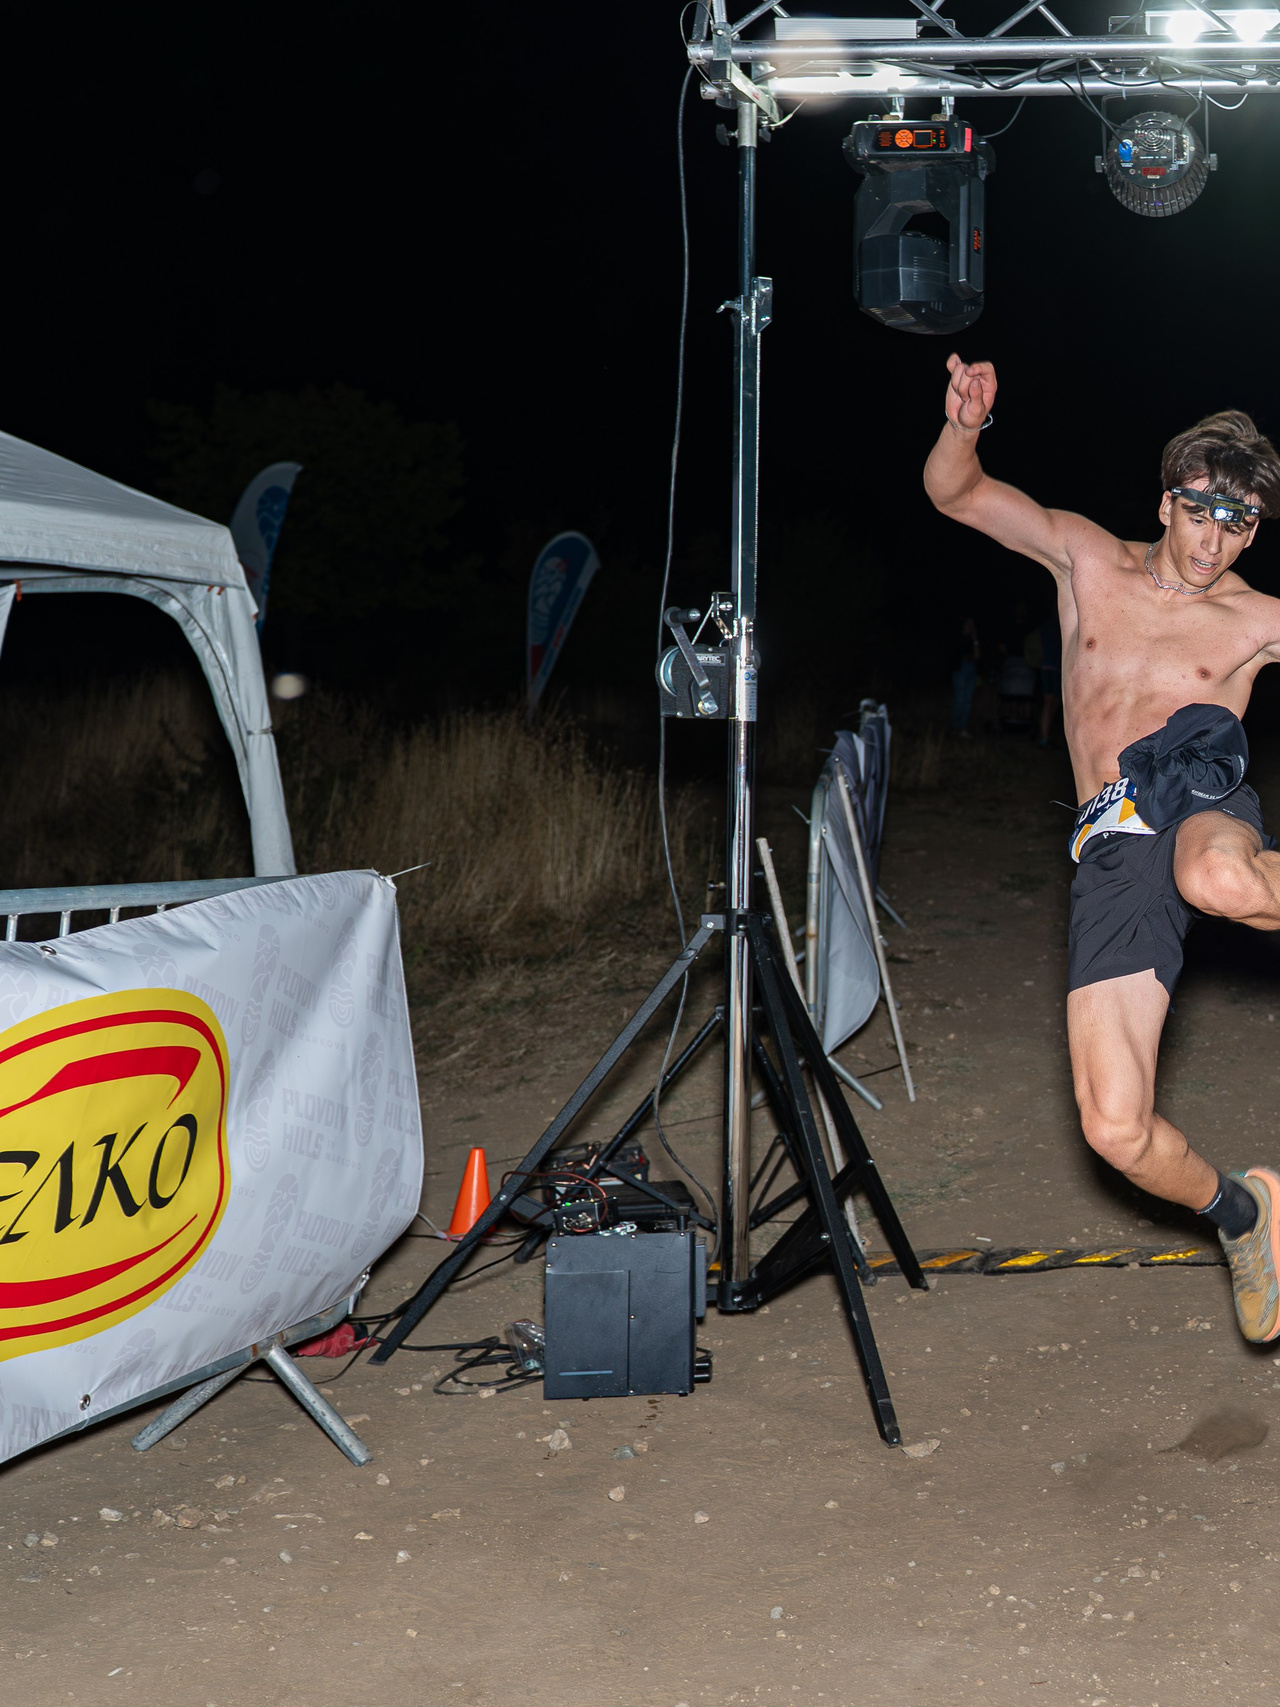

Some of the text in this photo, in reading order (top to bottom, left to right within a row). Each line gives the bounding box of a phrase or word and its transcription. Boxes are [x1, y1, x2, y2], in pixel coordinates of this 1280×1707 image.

[277, 963, 321, 1012] PLOVDIV
[268, 998, 299, 1039] HILLS
[282, 1087, 349, 1132] PLOVDIV
[281, 1123, 325, 1160] HILLS
[293, 1209, 354, 1249] PLOVDIV
[277, 1244, 322, 1277] HILLS
